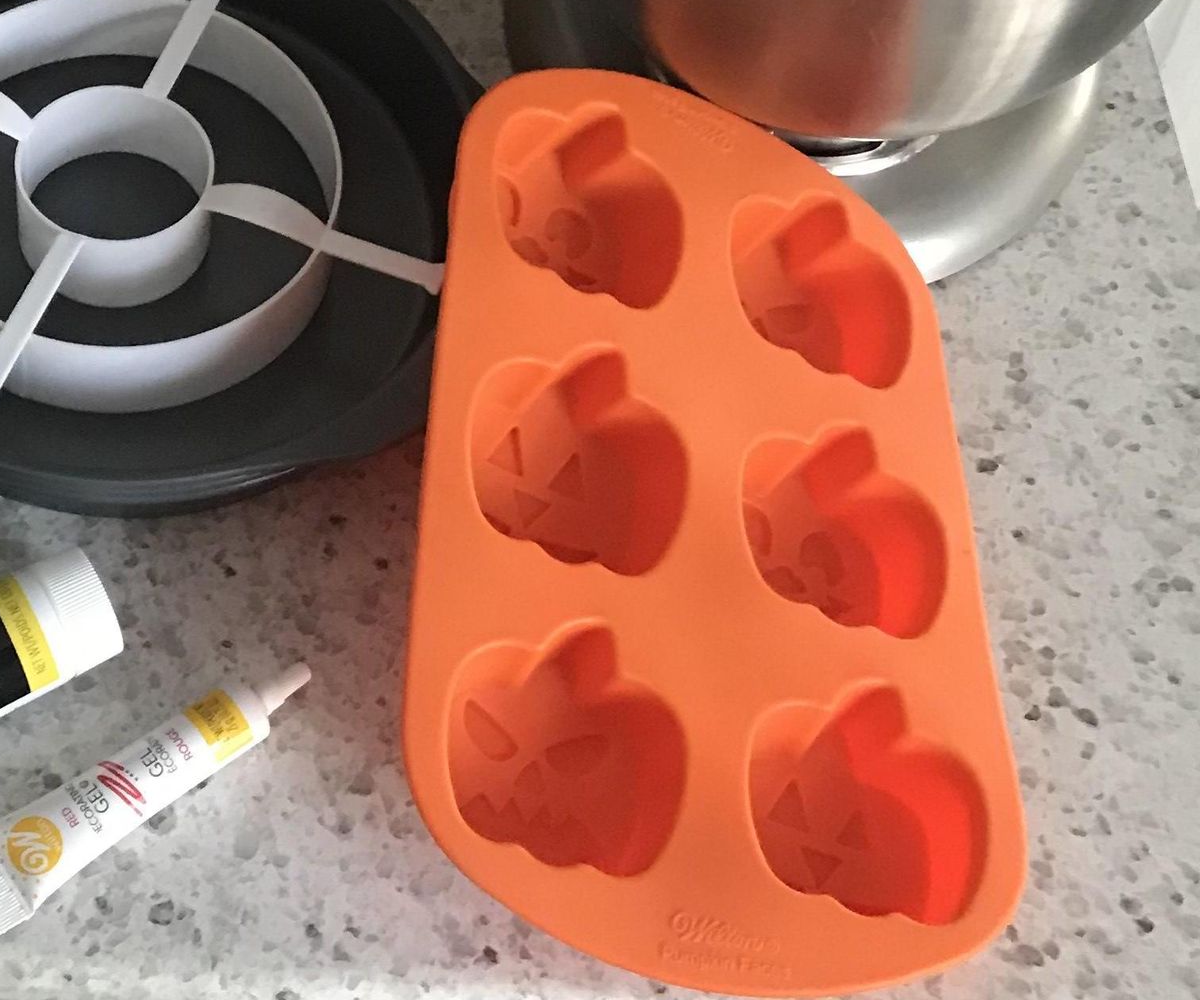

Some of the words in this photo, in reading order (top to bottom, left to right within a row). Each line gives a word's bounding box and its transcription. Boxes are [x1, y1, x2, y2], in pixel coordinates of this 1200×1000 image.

[164, 727, 194, 761] ROUGE
[140, 747, 164, 777] GEL
[85, 783, 110, 814] GEL
[62, 807, 80, 828] RED
